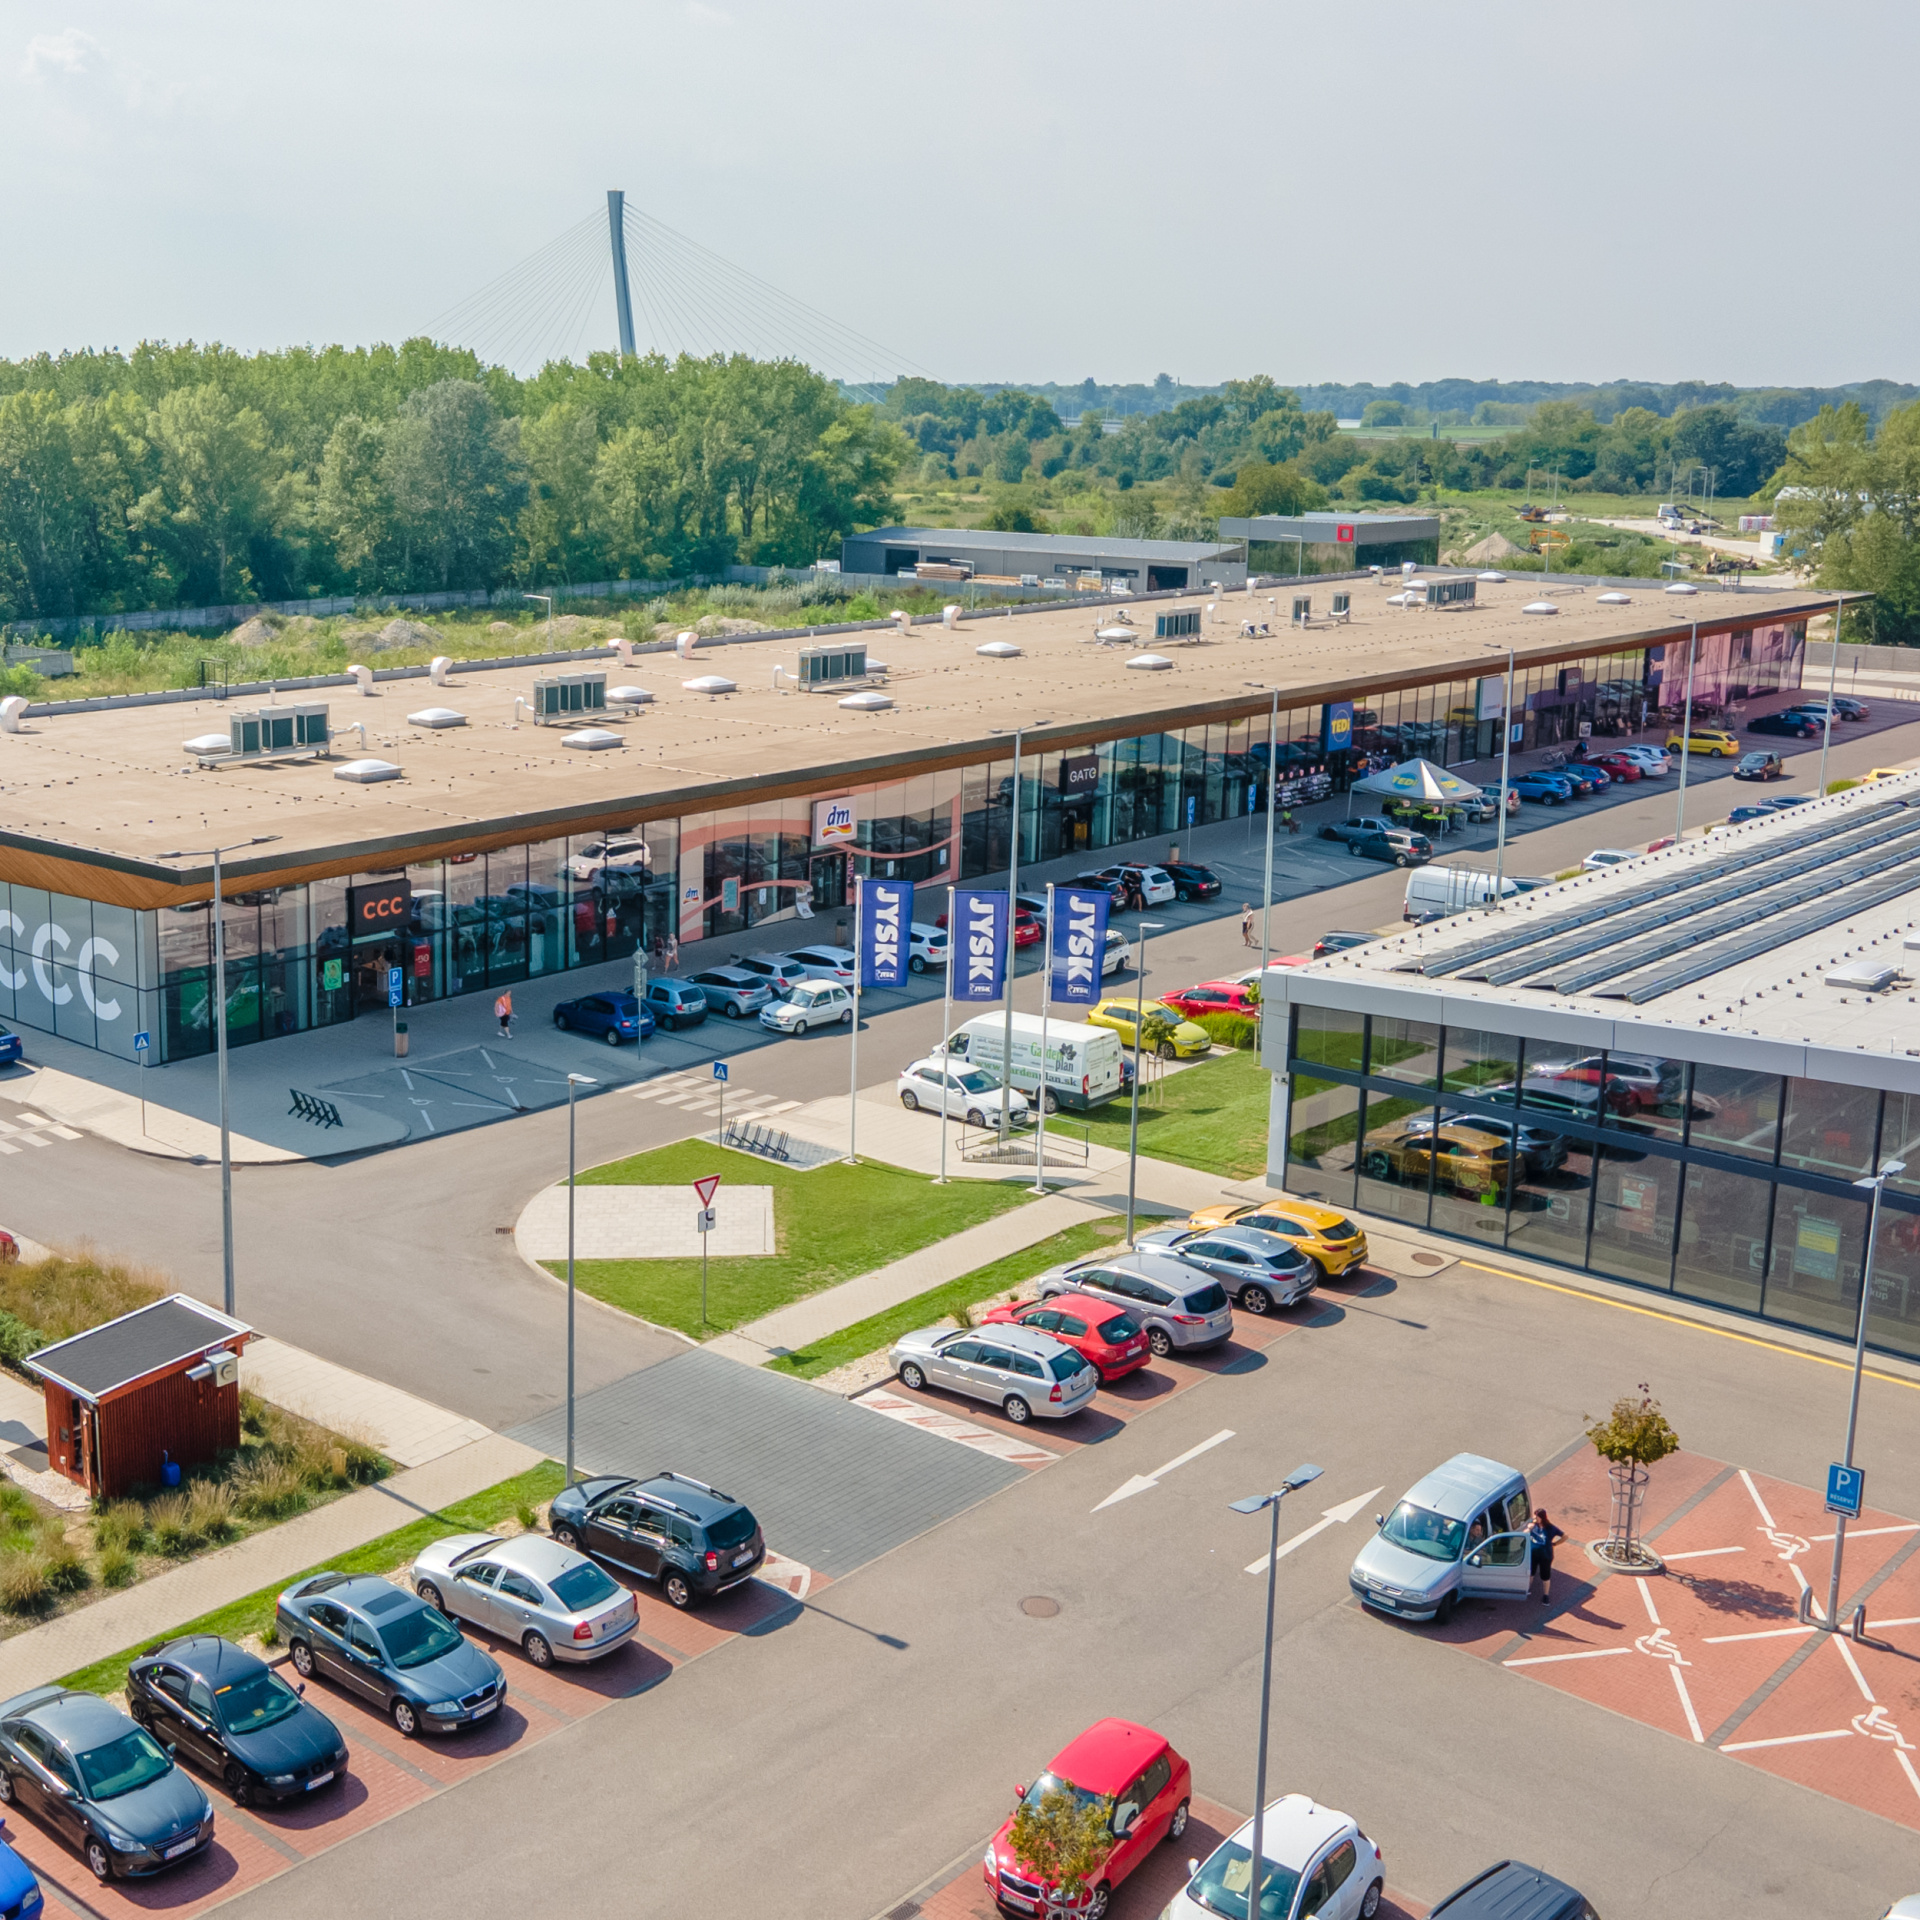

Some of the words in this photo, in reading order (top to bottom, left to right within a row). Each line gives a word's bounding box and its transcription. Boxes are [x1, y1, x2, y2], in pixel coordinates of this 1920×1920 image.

[827, 805, 850, 827] dm
[685, 888, 699, 899] dm
[363, 896, 403, 920] CCC
[874, 886, 900, 968] JYSK
[968, 897, 995, 981] JYSK
[1067, 895, 1096, 983] JYSK
[392, 971, 399, 984] P
[1030, 1041, 1064, 1061] Gaden
[975, 1060, 1077, 1087] www.ardenlan.sk
[1055, 1055, 1074, 1073] plan
[1836, 1469, 1851, 1491] P
